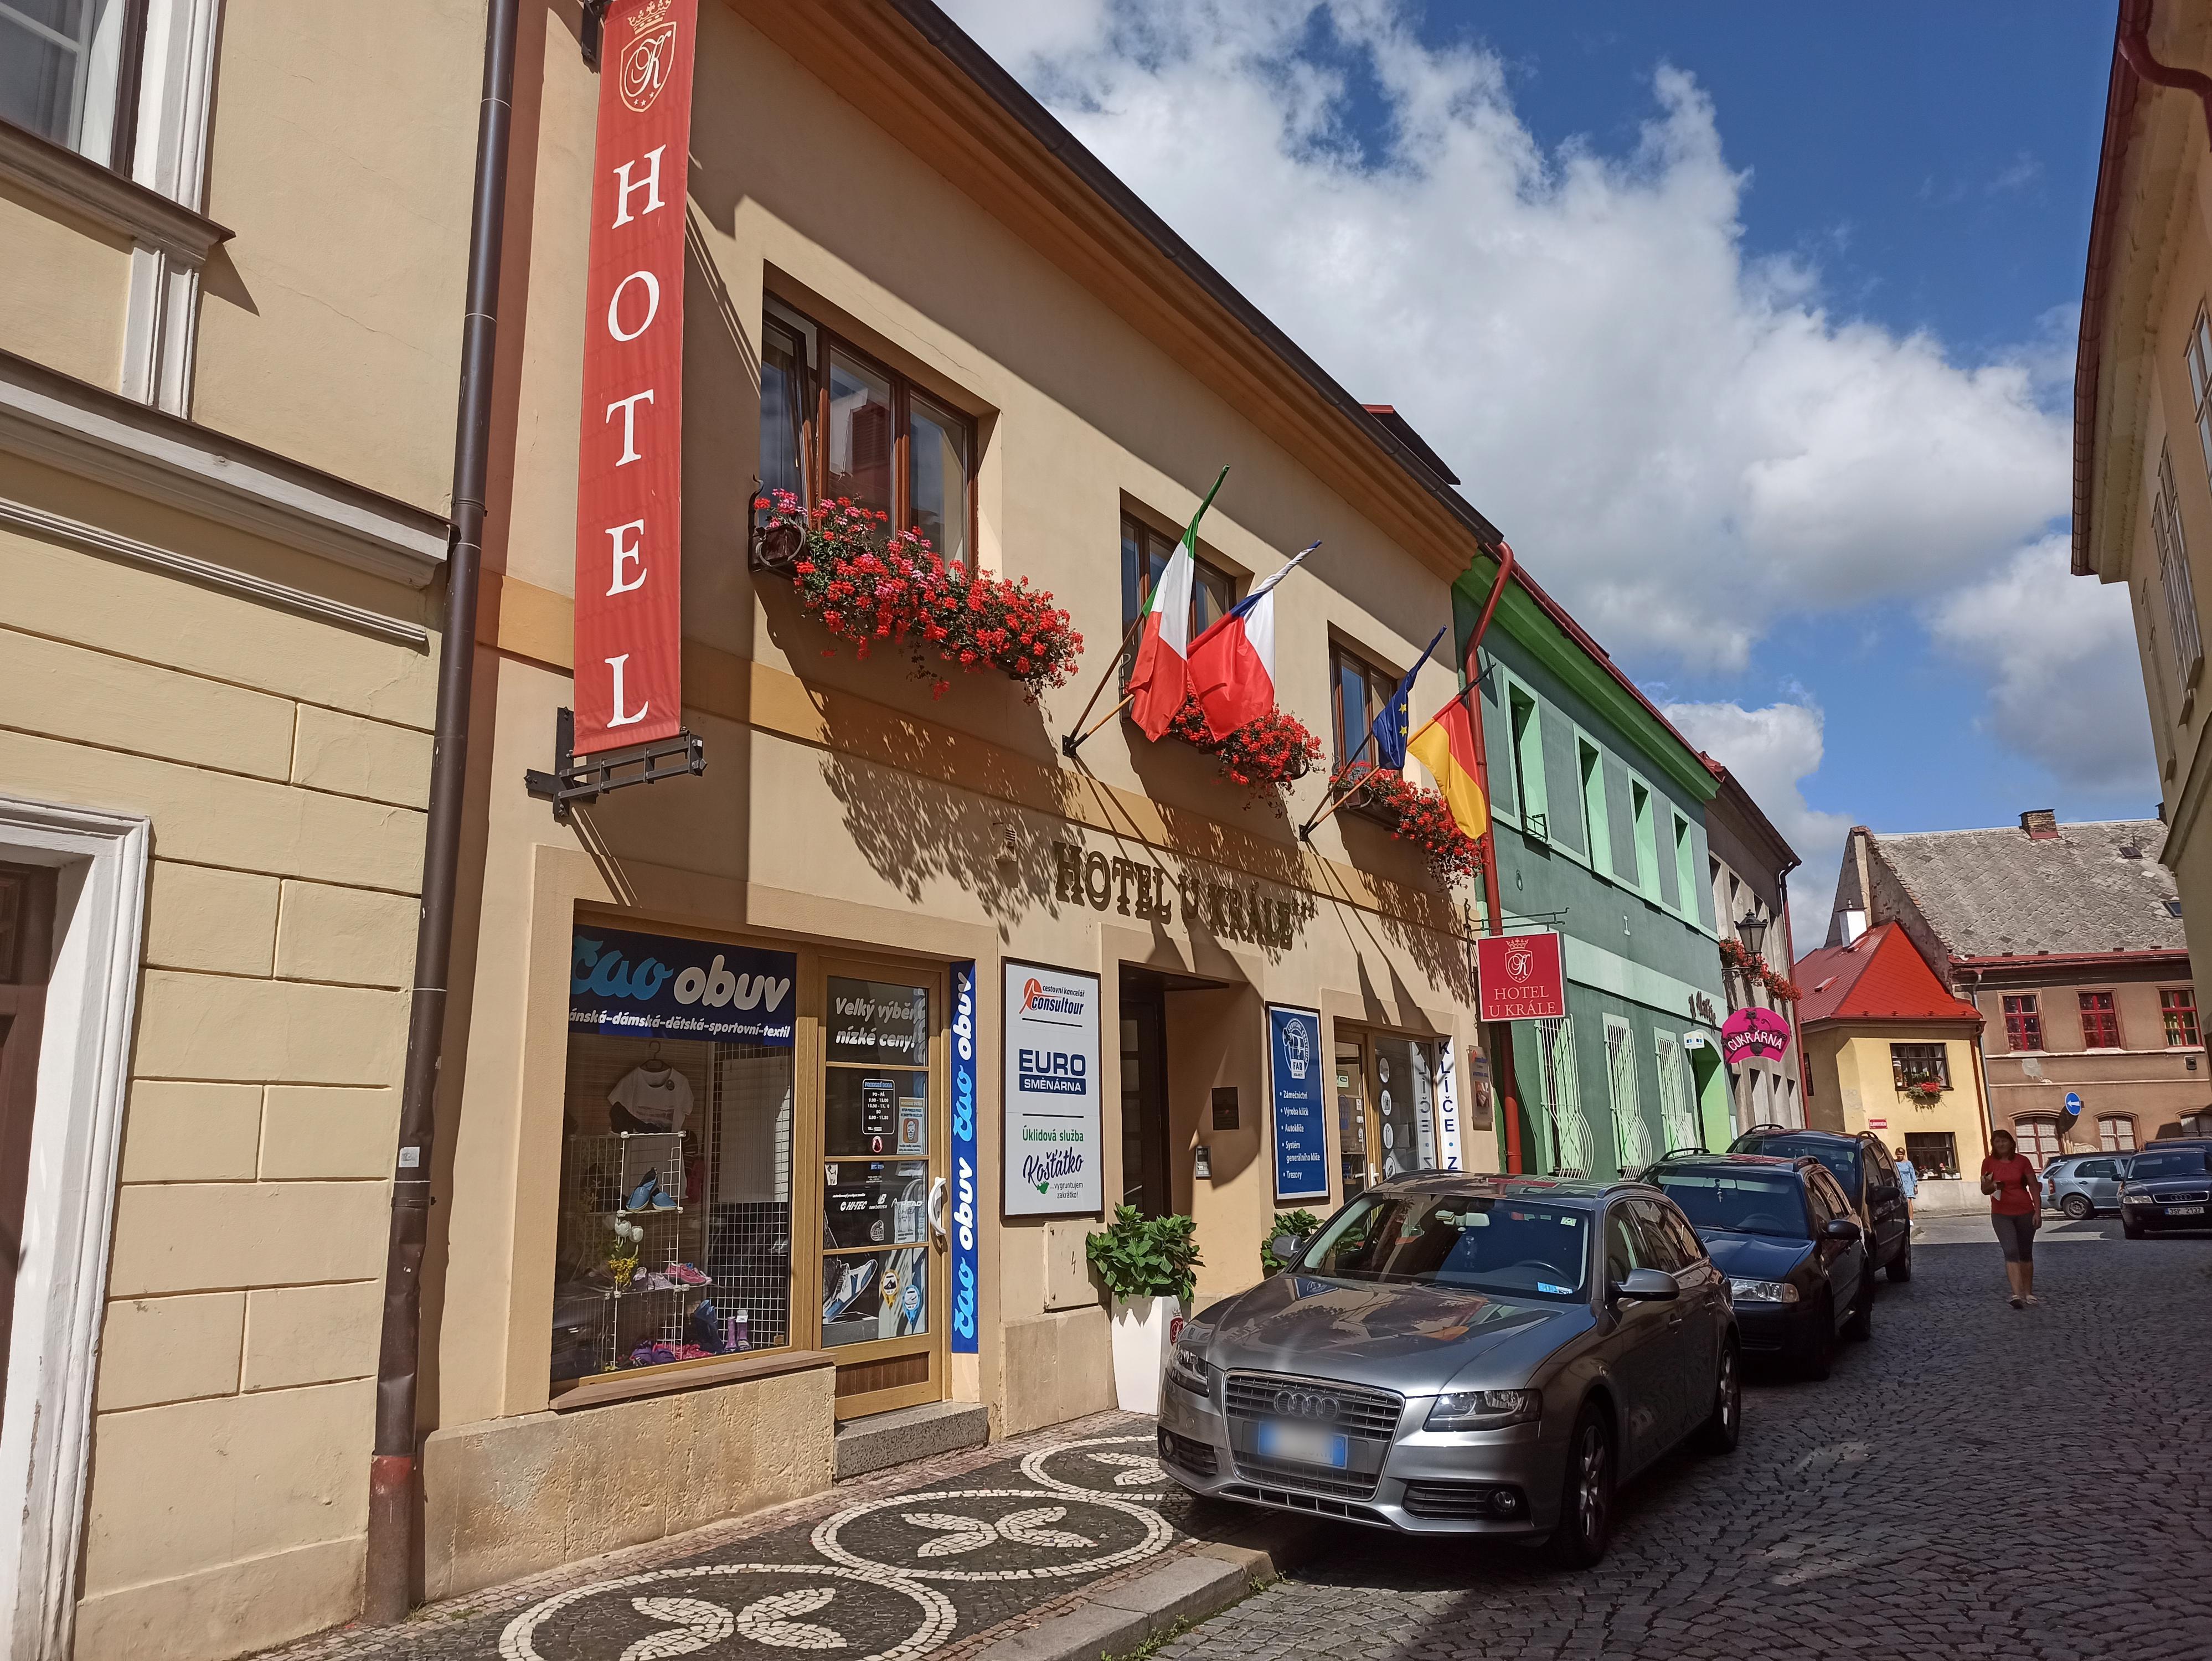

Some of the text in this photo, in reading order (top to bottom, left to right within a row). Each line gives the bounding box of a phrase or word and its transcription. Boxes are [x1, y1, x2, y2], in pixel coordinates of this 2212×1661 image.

[605, 144, 667, 729] HOTEL
[1053, 840, 1172, 926] HOTEL
[1177, 873, 1200, 920] U
[673, 955, 791, 1013] obuv
[1042, 984, 1085, 998] cestovní kancelář
[1494, 986, 1549, 1000] HOTEL
[836, 997, 915, 1024] Velký výběr
[1032, 996, 1084, 1015] consultour
[1488, 1000, 1557, 1017] U KRÁLE
[569, 1008, 791, 1038] ánská-dámská-dětská-sportovní-textil
[952, 972, 972, 1061] obuv
[835, 1025, 916, 1053] nízké ceny!
[1727, 1029, 1783, 1052] CUKRÁRNA
[1019, 1049, 1086, 1077] EURO
[1293, 1061, 1303, 1071] FAB
[1024, 1077, 1082, 1092] SMĚNÁRNA
[1438, 1041, 1455, 1132] KLÍČE
[1283, 1090, 1308, 1100] Zámečnictví
[1283, 1107, 1309, 1117] Výroba klíčů
[1022, 1124, 1084, 1142] Úklidová služba
[1285, 1124, 1304, 1133] Autoklíče
[1285, 1141, 1301, 1151] Systém
[1023, 1146, 1084, 1184] Košťátko
[1286, 1153, 1321, 1164] generálního klíče
[1286, 1170, 1302, 1180] Trezory
[846, 1200, 868, 1211] HI-TEC
[900, 1200, 922, 1208] HEAD
[953, 1156, 973, 1251] obuv
